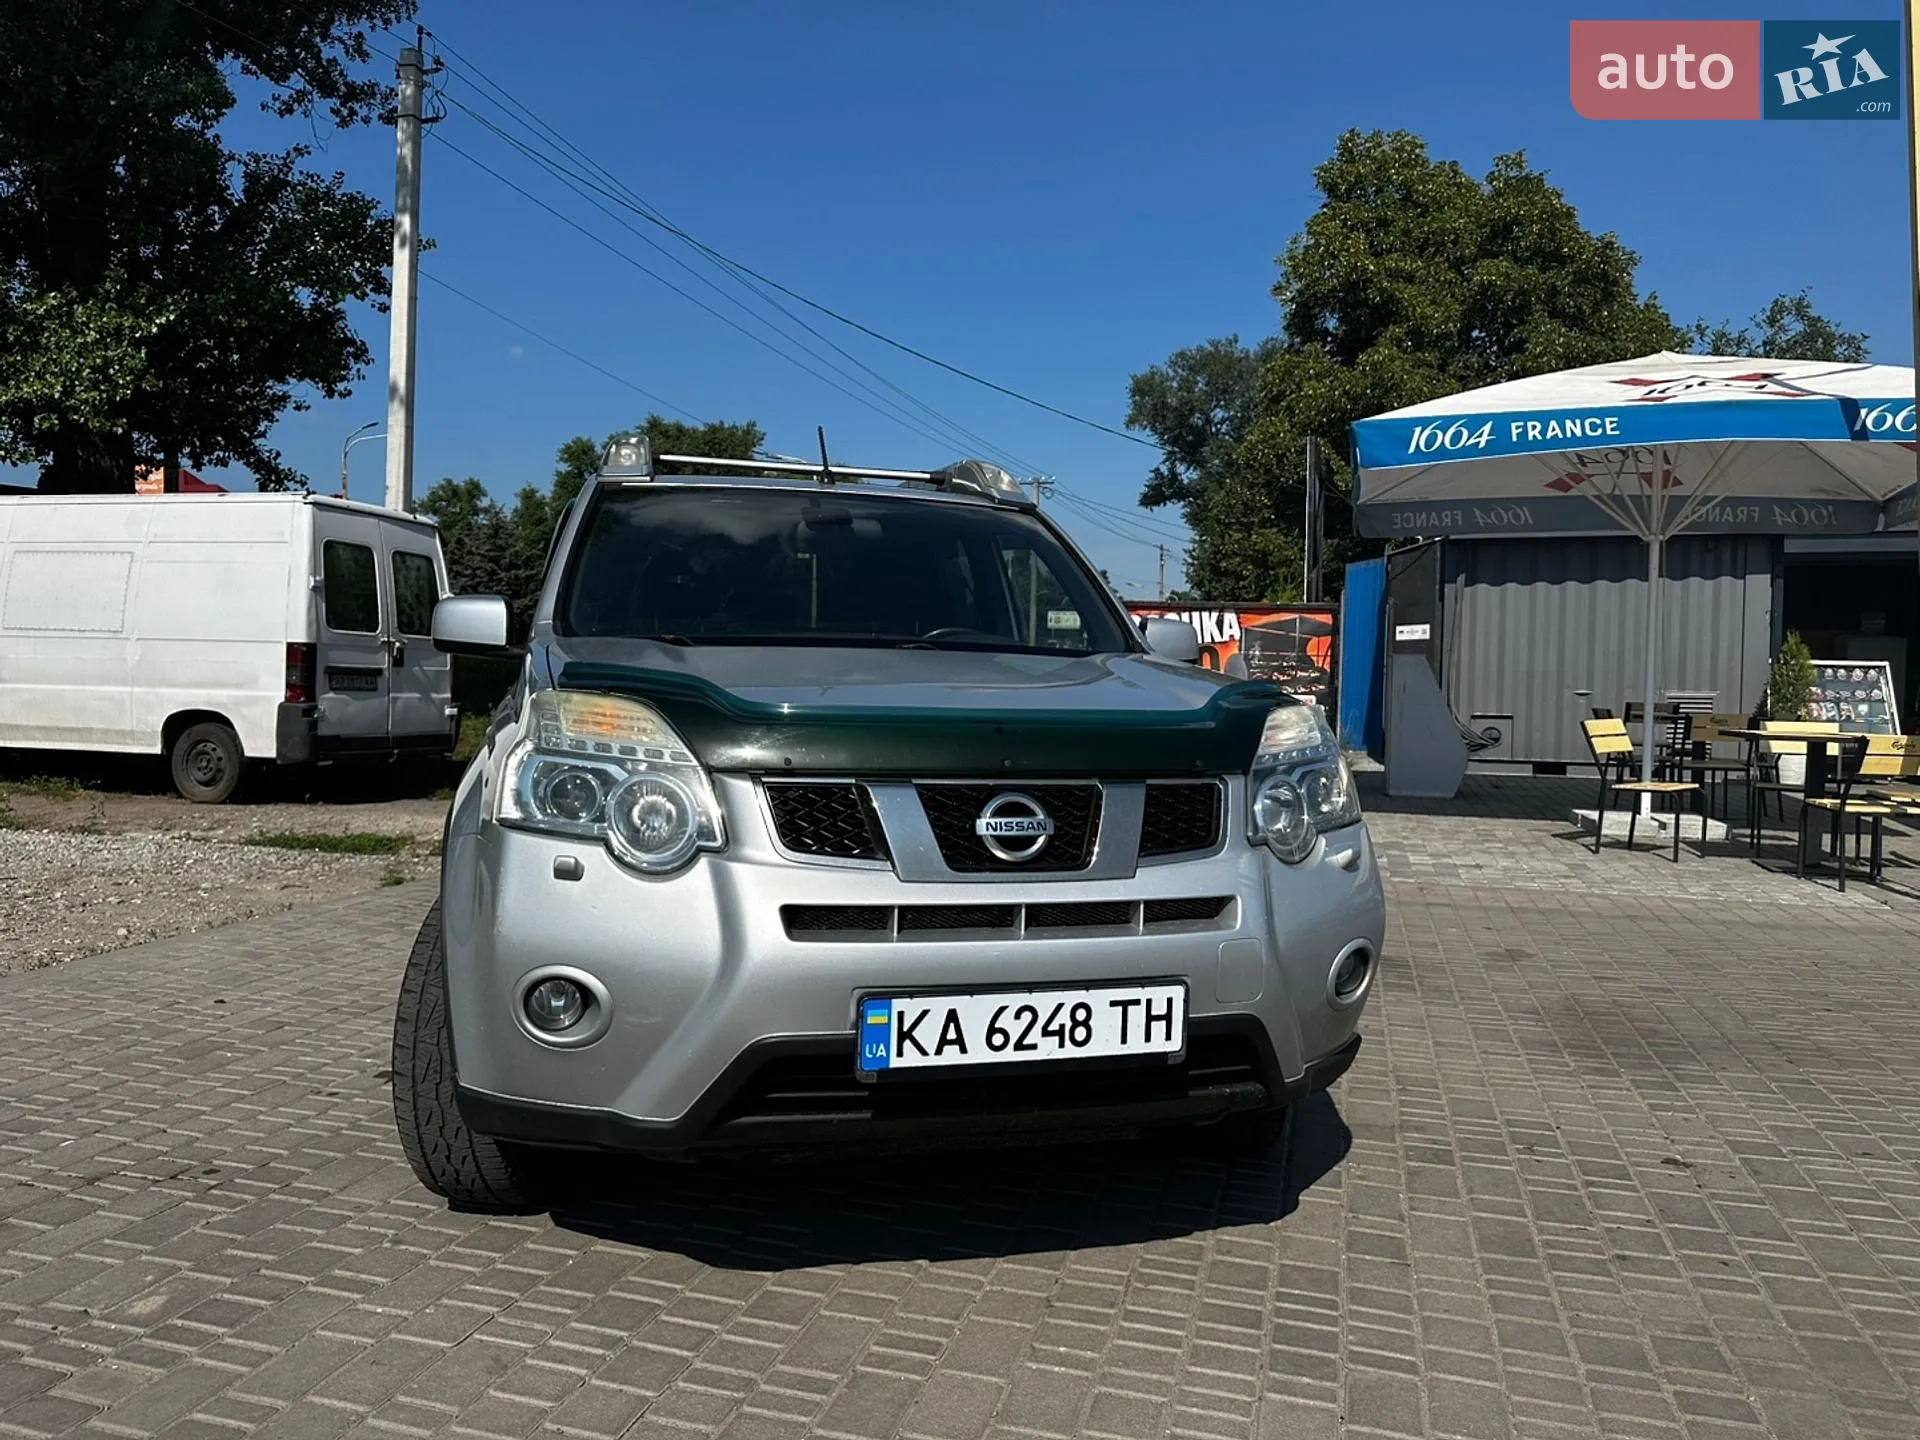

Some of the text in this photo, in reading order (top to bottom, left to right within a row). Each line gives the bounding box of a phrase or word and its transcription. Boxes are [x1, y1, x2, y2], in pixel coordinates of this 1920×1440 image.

[1408, 417, 1620, 454] 1664 FRANCE
[985, 820, 1047, 833] NISSAN
[896, 997, 1174, 1058] KA 6248 TH
[865, 1043, 887, 1059] UA
